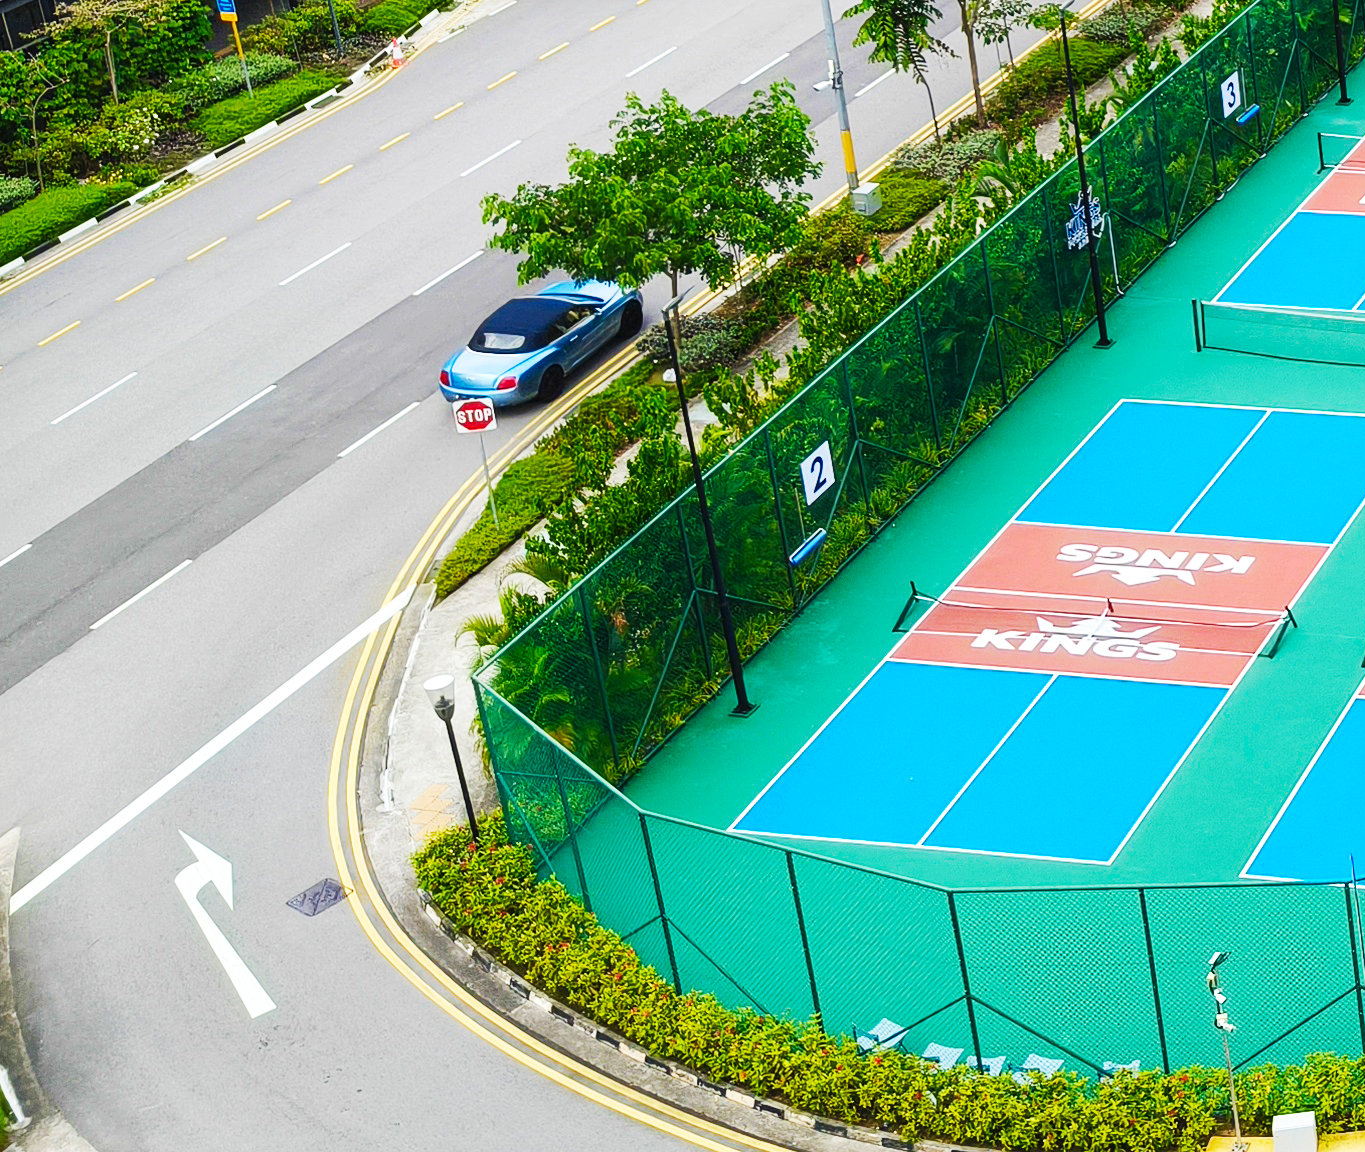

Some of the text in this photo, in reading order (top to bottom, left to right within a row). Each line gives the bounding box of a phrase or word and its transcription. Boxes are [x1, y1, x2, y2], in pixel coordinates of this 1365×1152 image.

[1227, 82, 1236, 108] 3
[457, 408, 492, 424] STOP
[811, 456, 827, 493] 2
[1056, 543, 1256, 575] KINGS
[970, 628, 1181, 662] KINGS
